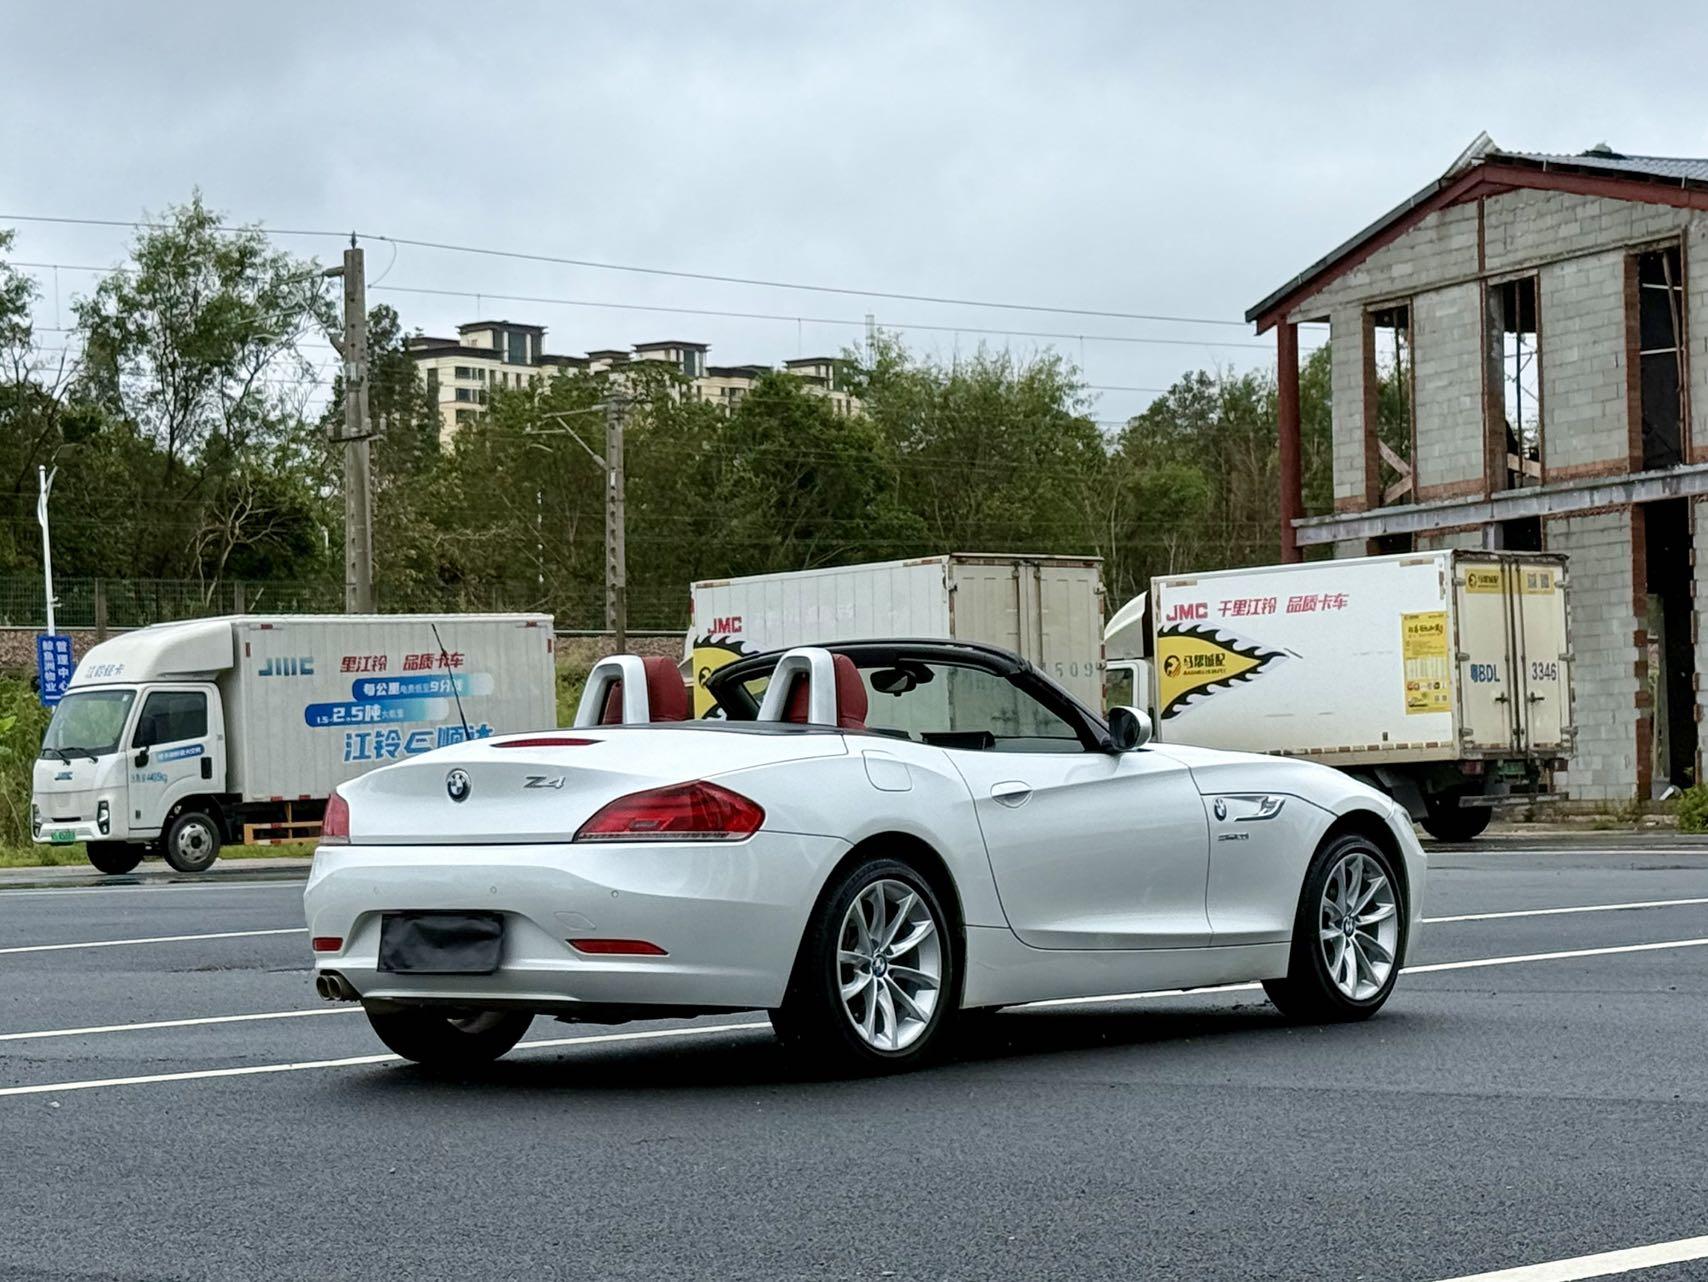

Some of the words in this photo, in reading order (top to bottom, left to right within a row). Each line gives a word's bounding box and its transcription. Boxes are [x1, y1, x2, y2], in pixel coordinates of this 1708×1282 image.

[1166, 603, 1208, 621] JMC
[1217, 597, 1277, 617] 千里江铃
[1286, 593, 1349, 613] 品质卡车
[707, 616, 742, 635] JMC
[340, 655, 388, 672] 里江铃
[402, 651, 465, 671] 品质卡车
[1531, 661, 1557, 681] 3346
[523, 776, 566, 789] Z4
